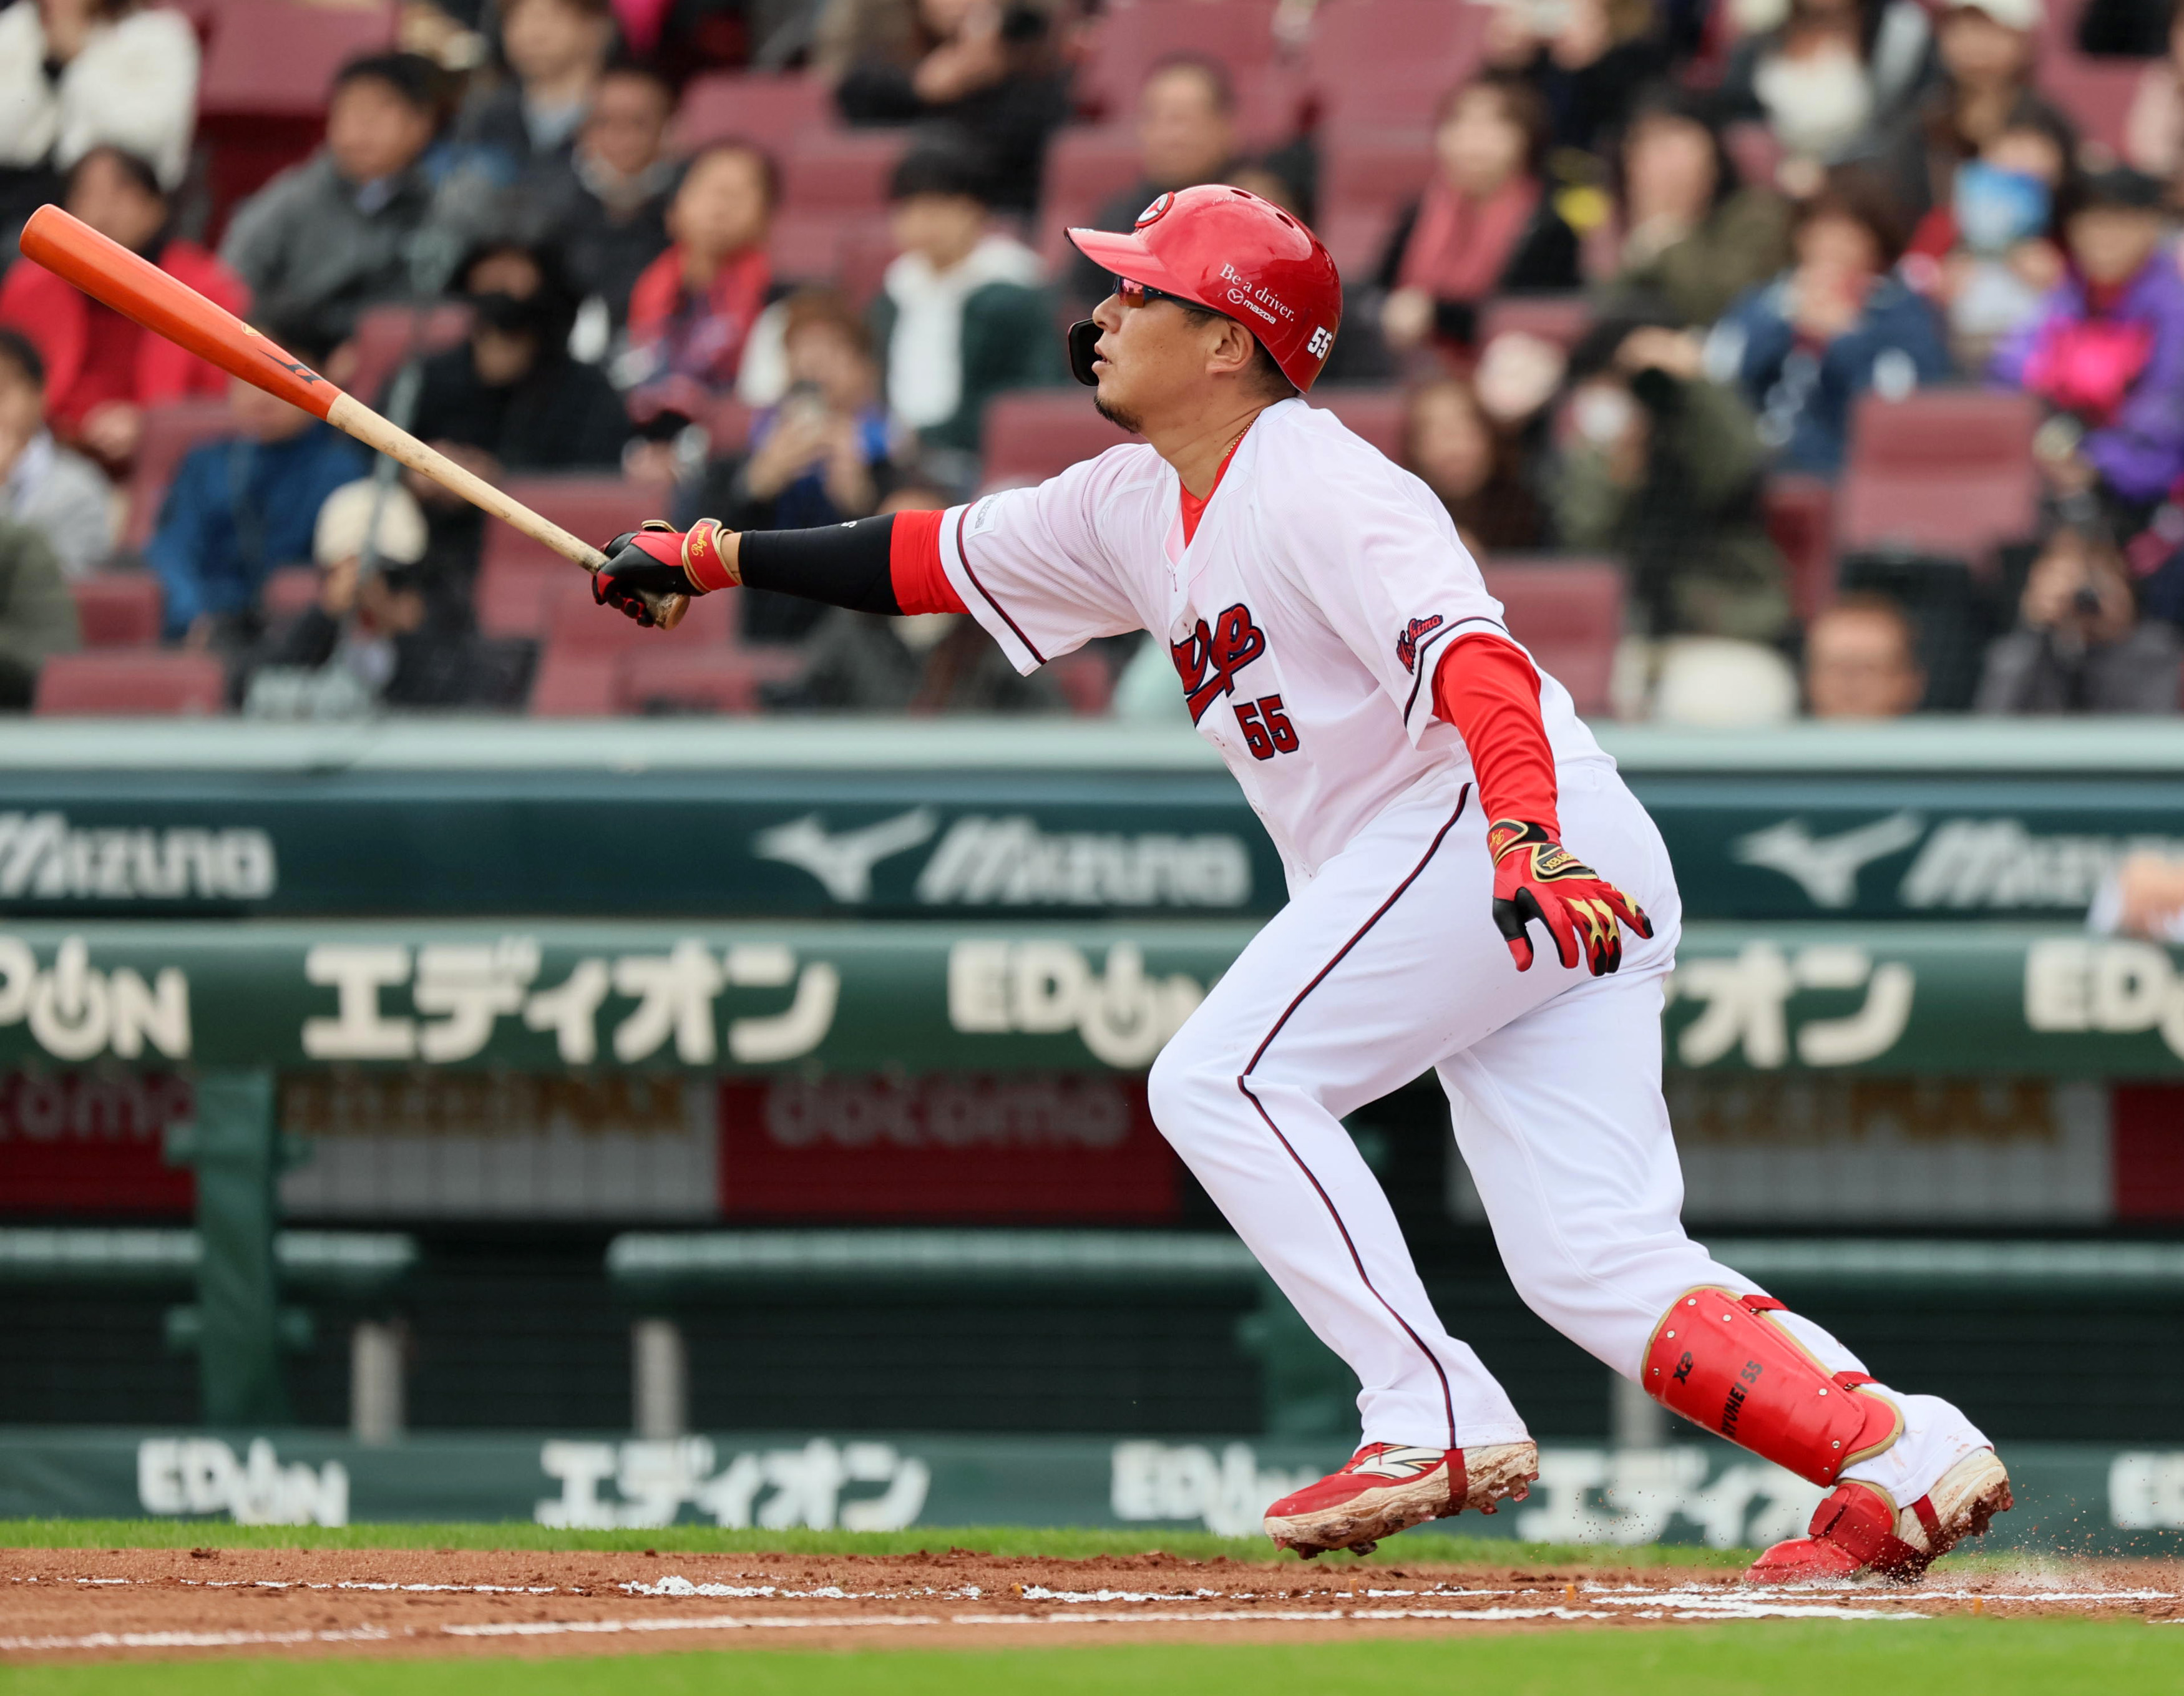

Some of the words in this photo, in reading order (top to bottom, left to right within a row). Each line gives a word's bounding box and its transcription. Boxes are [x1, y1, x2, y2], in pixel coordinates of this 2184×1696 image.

[1219, 263, 1242, 285] Be
[1243, 281, 1252, 293] a
[1255, 287, 1295, 322] driver.
[1307, 325, 1333, 360] 55
[1232, 693, 1300, 761] 55
[301, 936, 840, 1063] エディオン
[535, 1436, 930, 1531] エディオン
